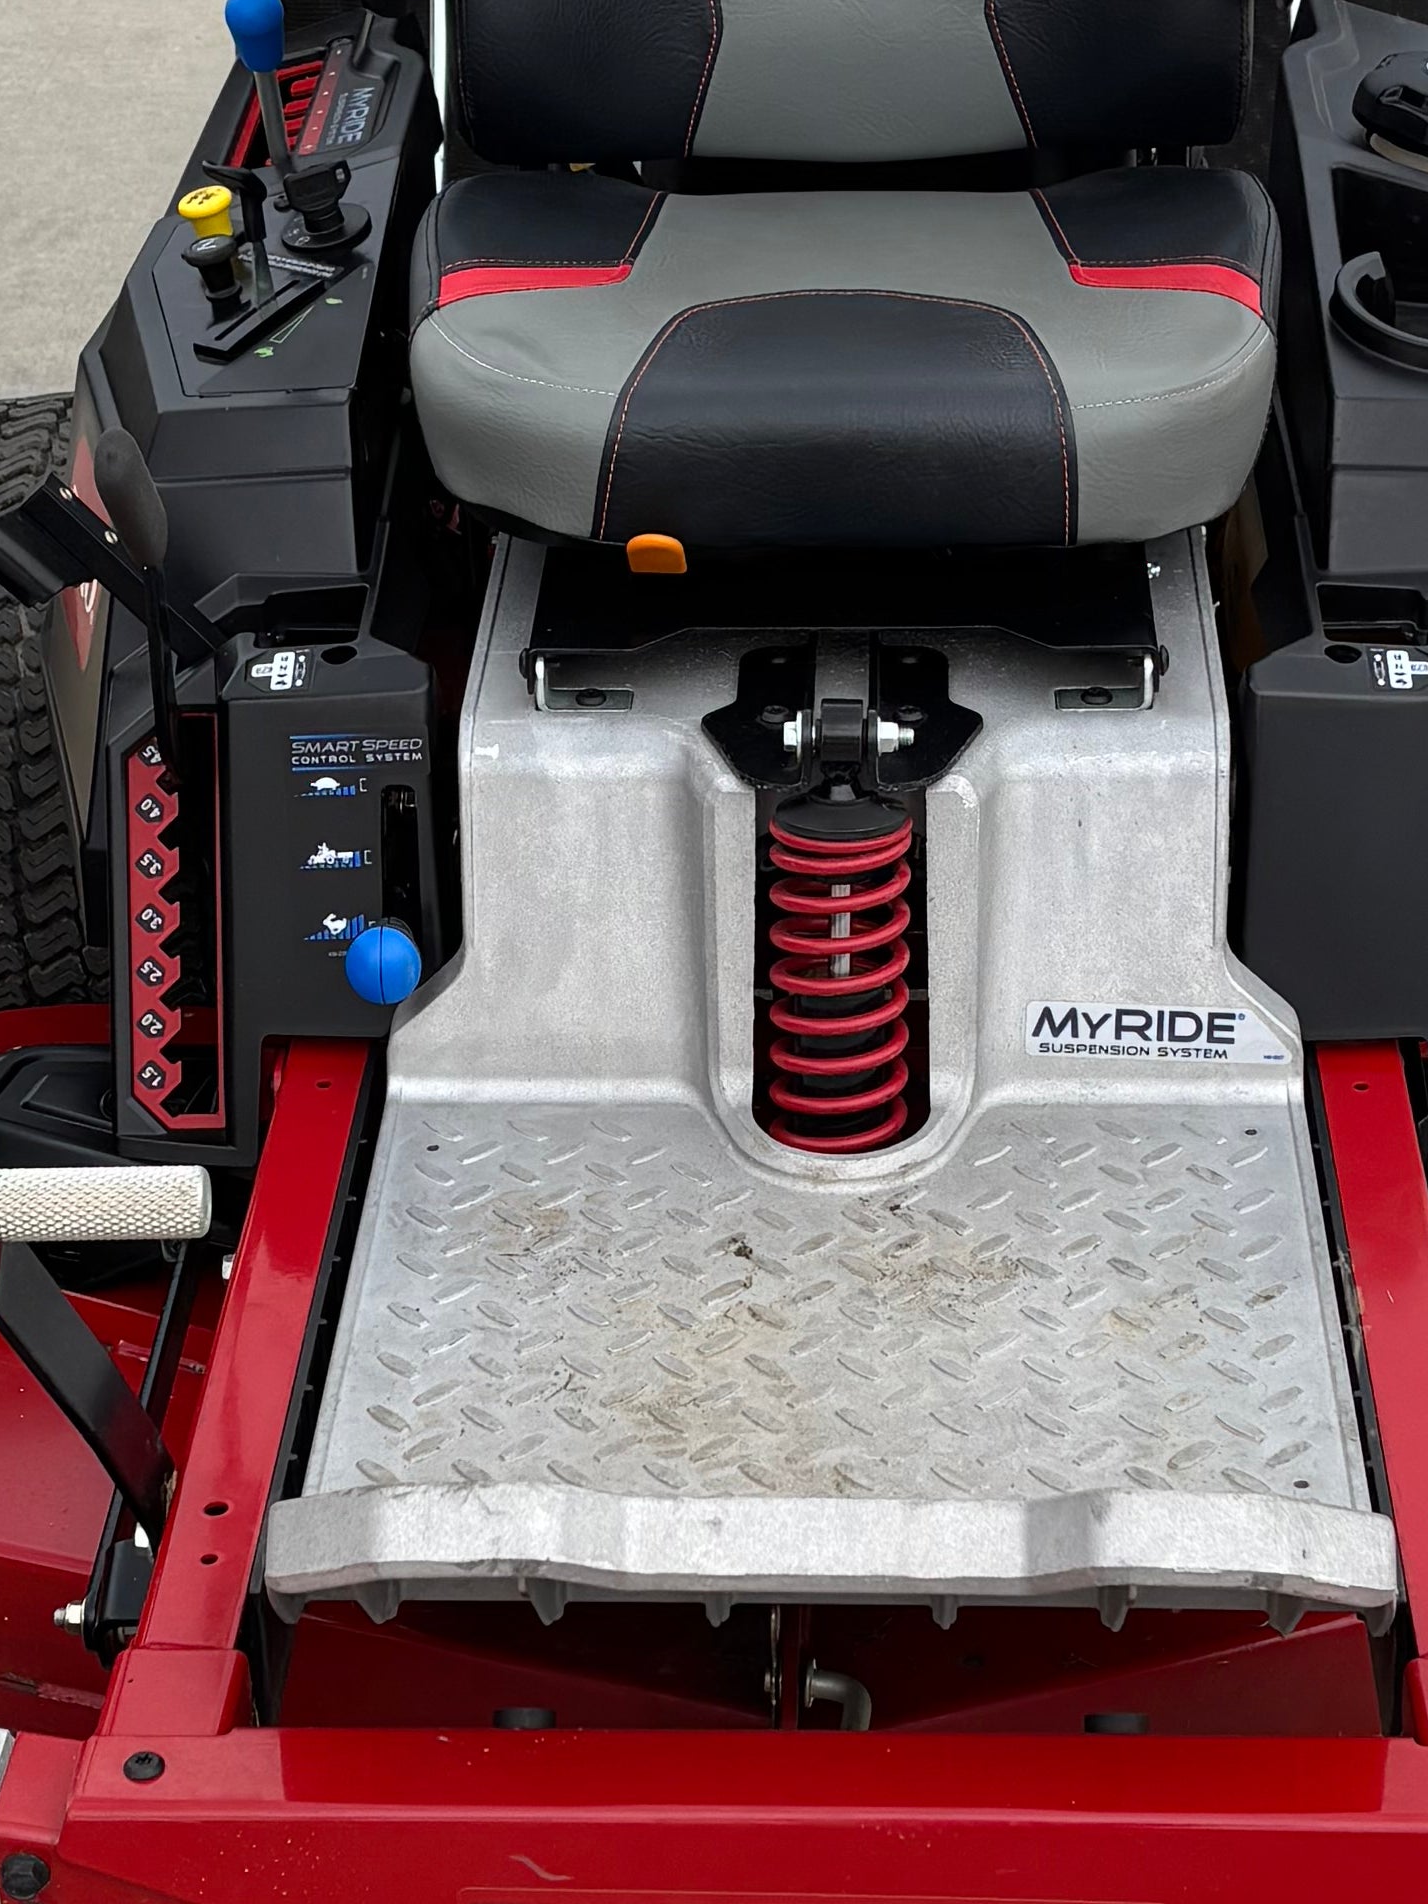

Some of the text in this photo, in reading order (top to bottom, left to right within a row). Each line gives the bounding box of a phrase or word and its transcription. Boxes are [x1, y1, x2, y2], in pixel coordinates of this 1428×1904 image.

[291, 738, 422, 754] SMART SPEED
[291, 752, 422, 765] CONTROL SYSTEM
[140, 798, 161, 818] 4.0
[140, 853, 162, 875] 3.5
[141, 908, 163, 930] 3.0
[140, 961, 163, 983] 2.5
[141, 1013, 164, 1035] 2.0
[1039, 1042, 1228, 1060] SUSPENSION SYSTEM
[141, 1066, 162, 1087] 1.5
